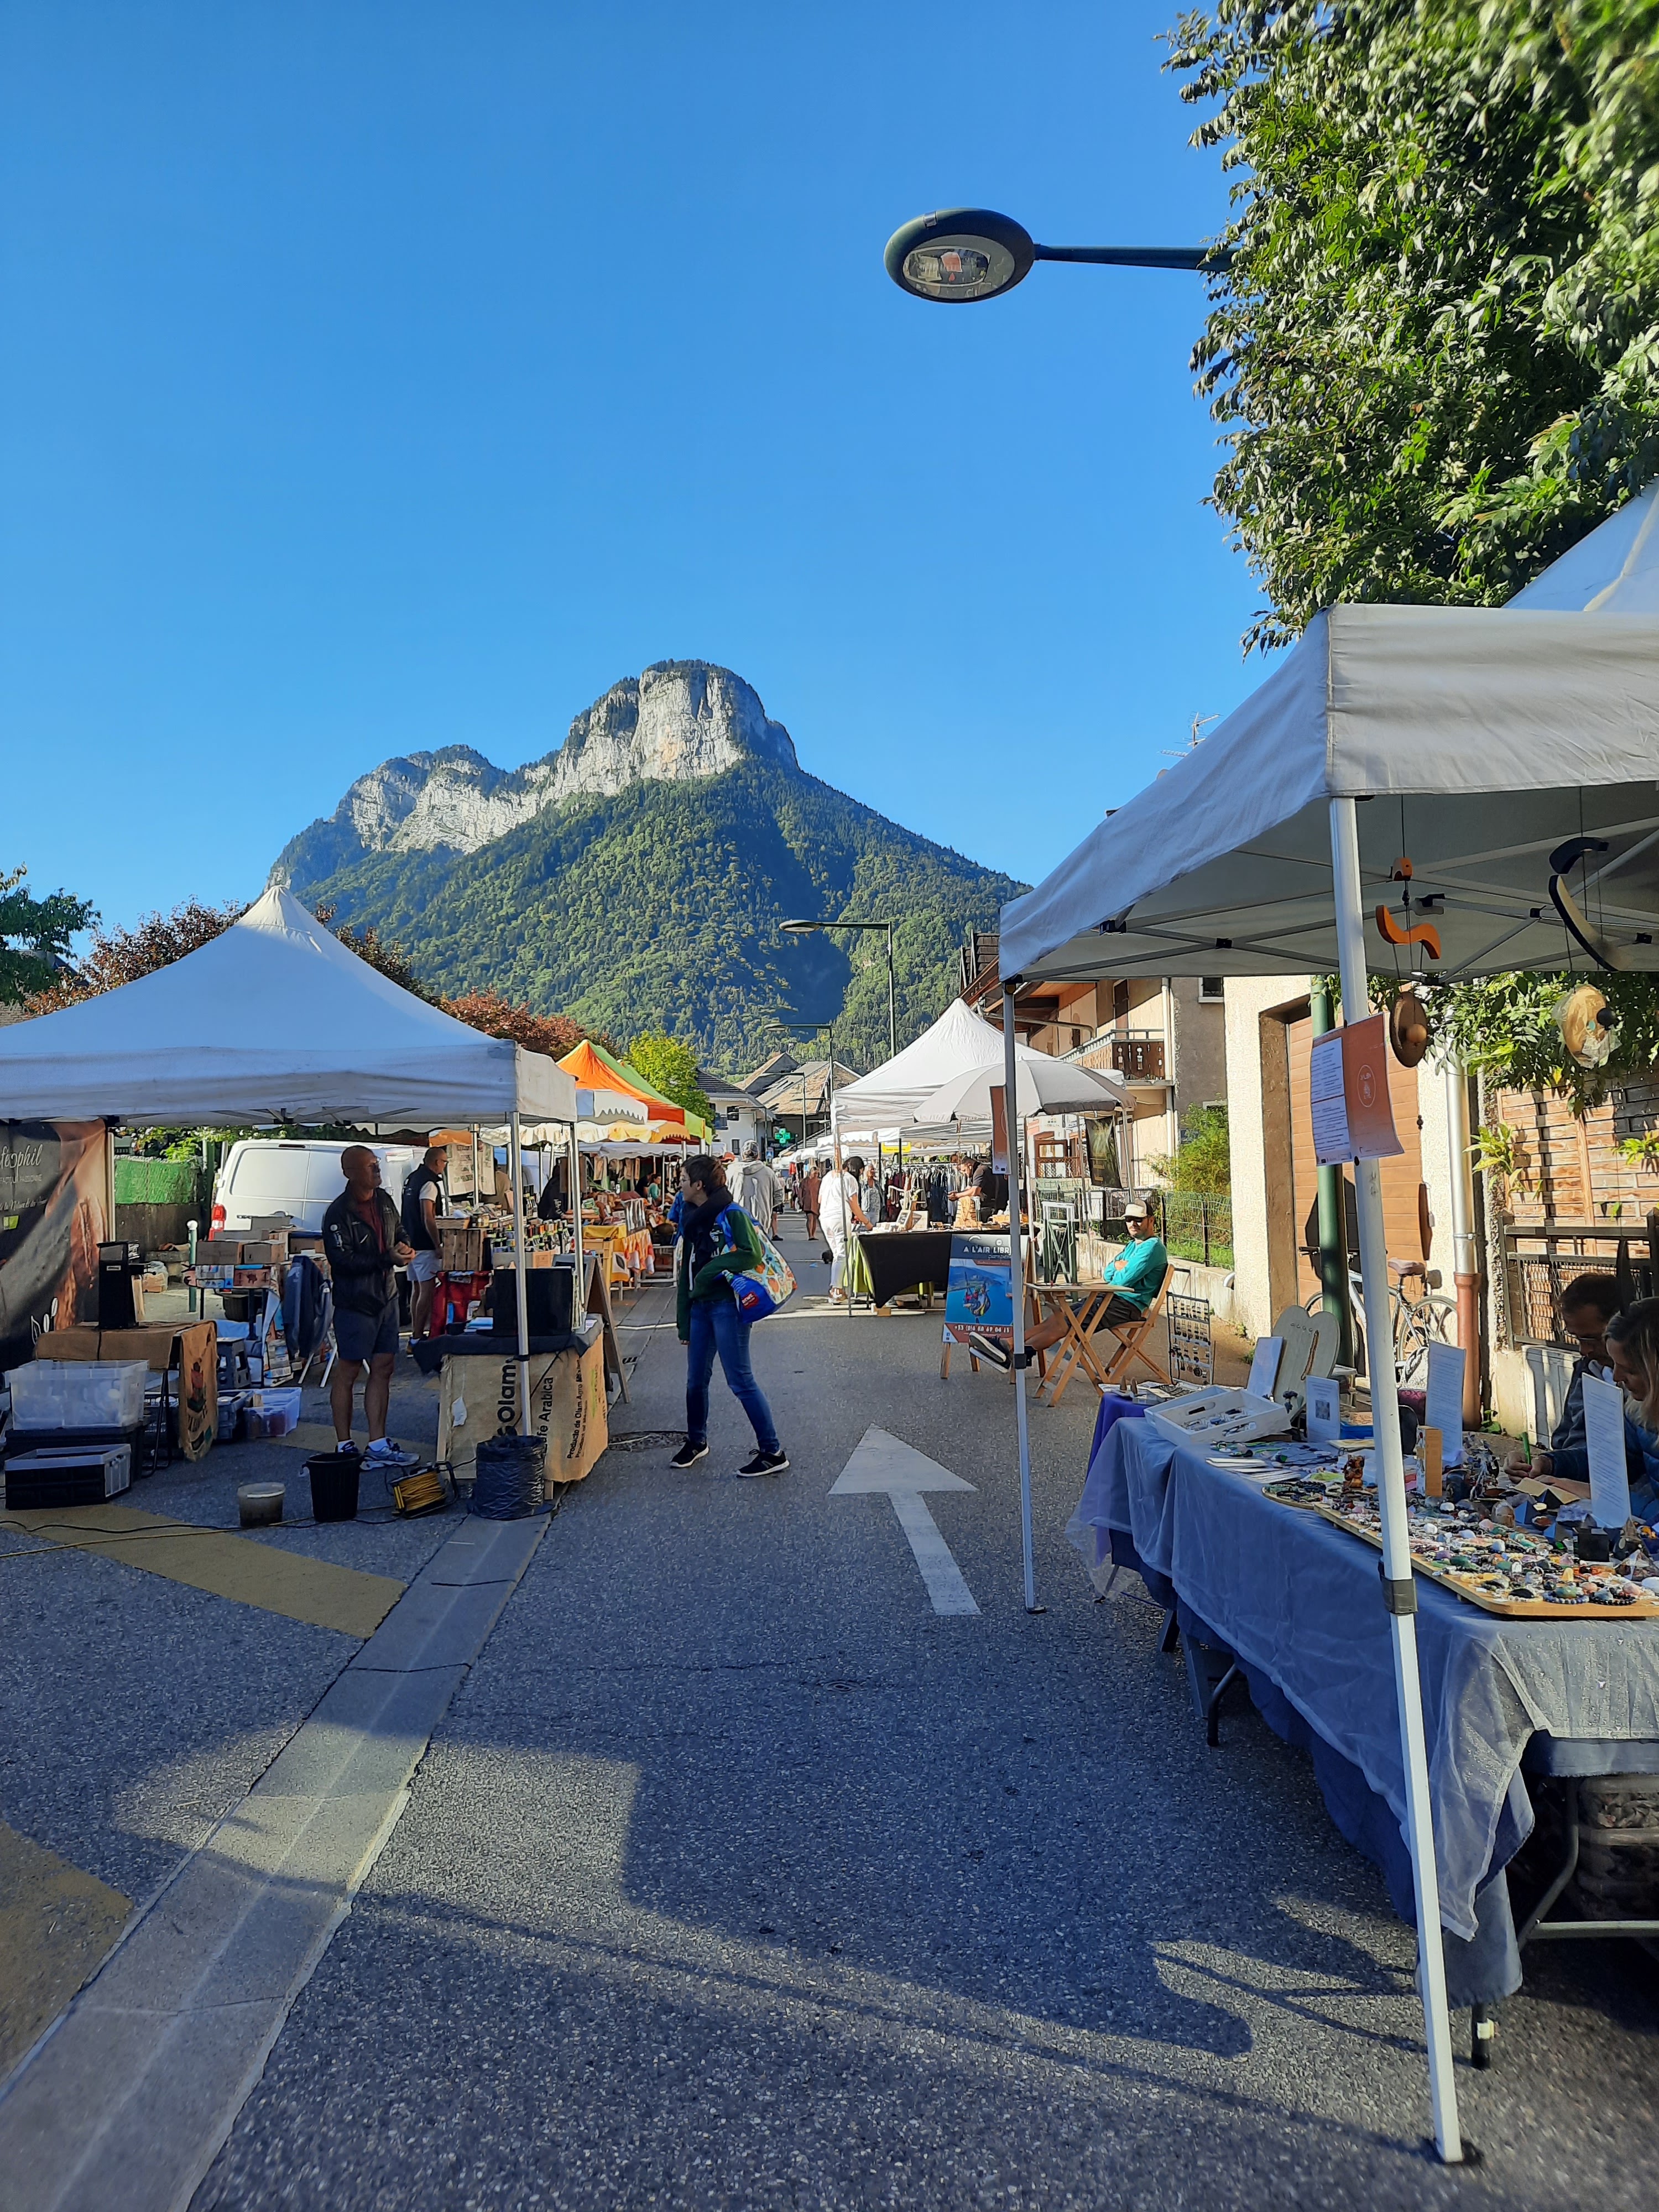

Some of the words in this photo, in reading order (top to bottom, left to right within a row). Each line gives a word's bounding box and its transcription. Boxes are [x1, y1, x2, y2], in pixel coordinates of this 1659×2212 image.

[993, 1246, 1011, 1254] LIBR
[497, 1364, 517, 1423] Olam
[539, 1376, 554, 1421] Arabica
[566, 1429, 580, 1459] Producto
